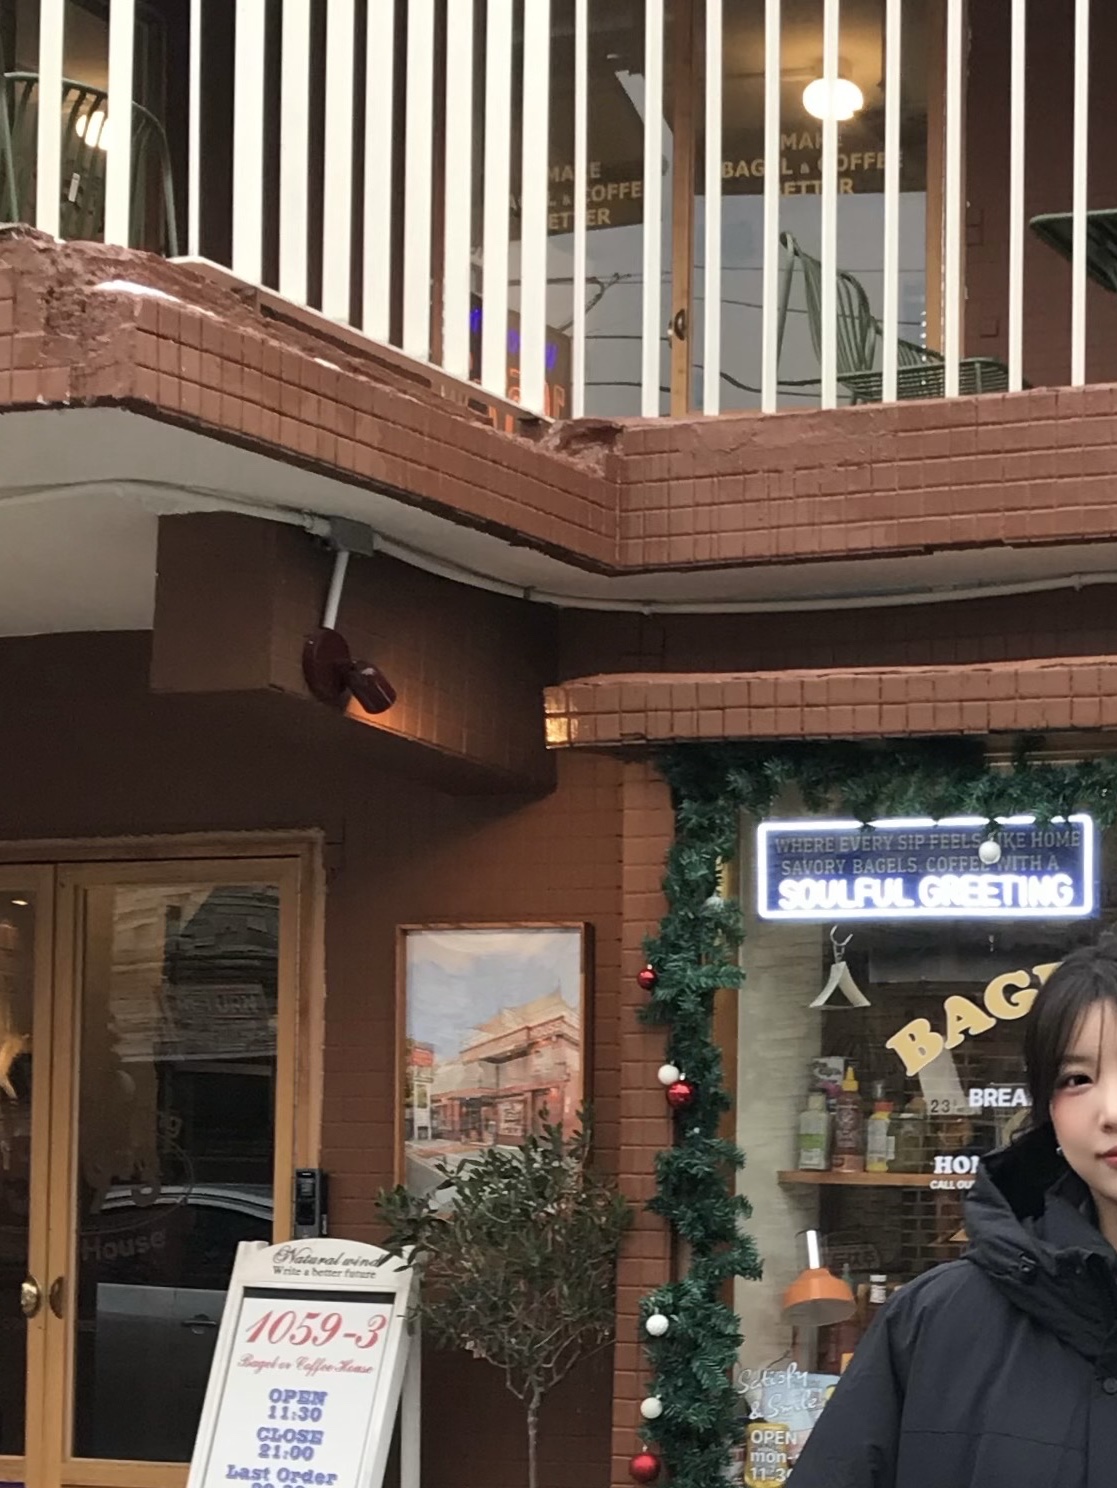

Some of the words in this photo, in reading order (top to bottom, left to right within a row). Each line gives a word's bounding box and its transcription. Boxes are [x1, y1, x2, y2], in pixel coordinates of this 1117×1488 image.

[549, 161, 601, 183] MAE
[722, 158, 793, 179] BAGL
[779, 178, 854, 196] ETTR
[549, 207, 611, 230] ETER
[775, 837, 835, 853] WHERE
[839, 835, 894, 852] EVERY
[897, 834, 925, 851] SIP
[928, 833, 981, 850] FEELS
[996, 831, 1026, 849] IKE
[1031, 831, 1080, 849] HOME
[781, 859, 846, 876] SAVORY
[998, 855, 1042, 872] WITH
[1047, 854, 1060, 871] A
[778, 876, 915, 910] SOULFUL
[918, 873, 1074, 908] GREETING
[884, 961, 1065, 1077] BAG
[968, 1088, 1032, 1108] BREA
[929, 1180, 955, 1190] CALL
[273, 1244, 345, 1266] Natural
[273, 1265, 301, 1277] Write
[303, 1268, 310, 1277] a
[312, 1267, 342, 1278] better
[344, 1268, 376, 1279] future
[246, 1310, 387, 1349] 1059-3
[238, 1353, 280, 1374] Bagel
[296, 1356, 334, 1377] Coffee
[334, 1359, 374, 1375] House
[268, 1388, 328, 1406] OPEN
[267, 1405, 322, 1423] 11:30
[749, 1400, 764, 1420] &
[256, 1427, 324, 1445] CLOSE
[750, 1429, 798, 1445] OPEN
[258, 1443, 315, 1461] 21:00
[750, 1451, 800, 1463] mon-
[225, 1464, 271, 1481] Last
[276, 1467, 338, 1486] Order
